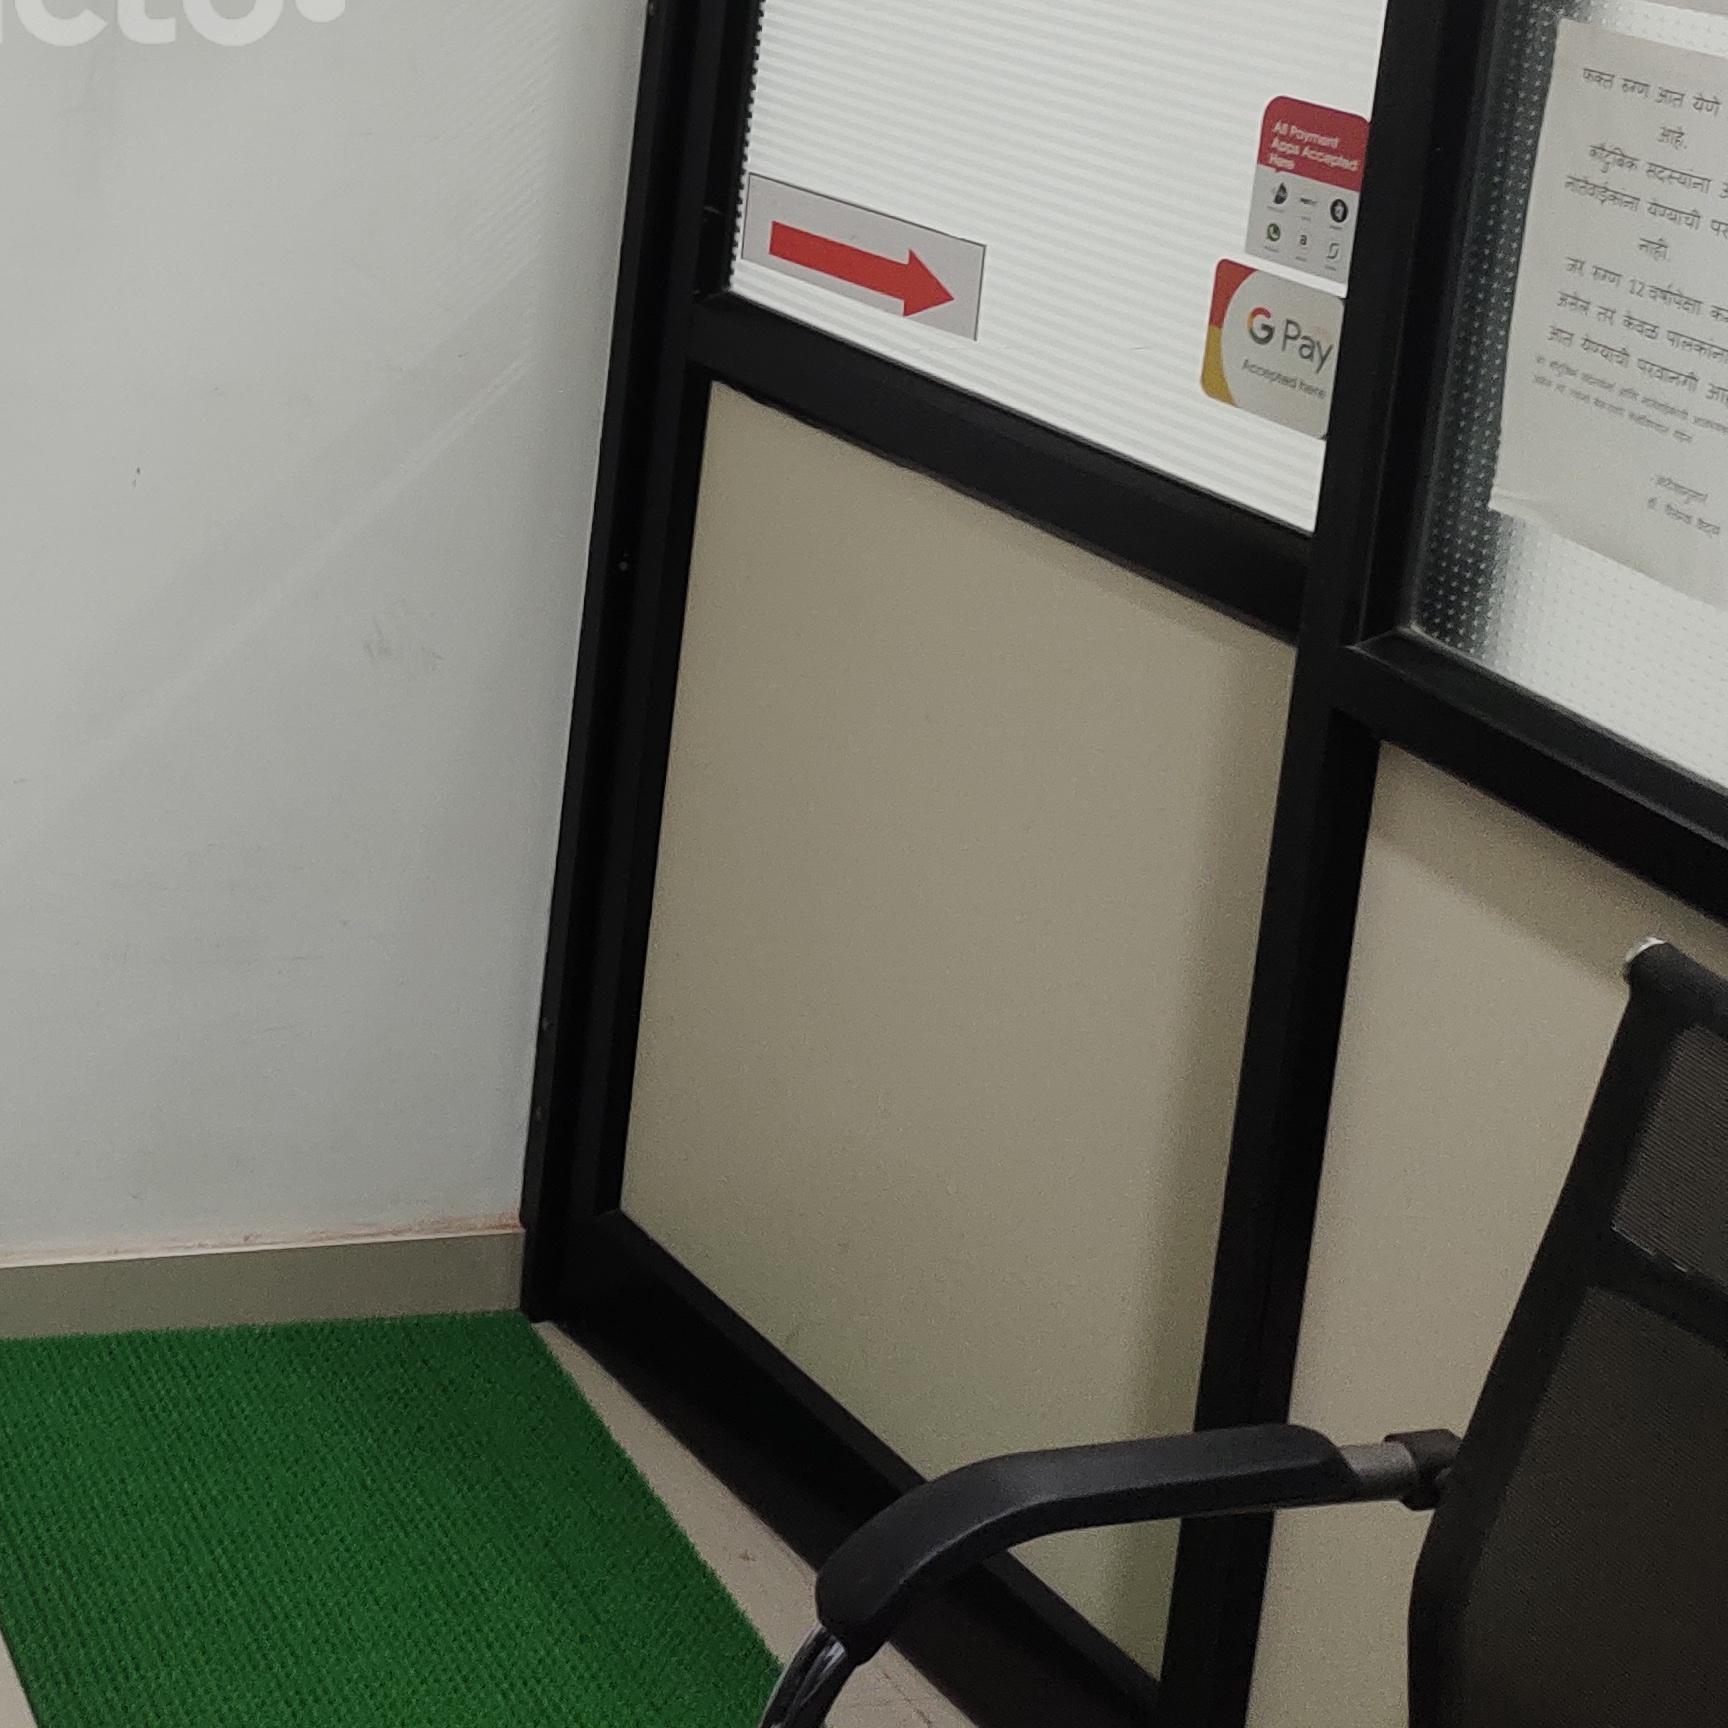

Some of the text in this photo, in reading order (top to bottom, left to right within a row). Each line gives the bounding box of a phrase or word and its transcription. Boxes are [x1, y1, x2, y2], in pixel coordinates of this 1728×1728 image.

[1272, 120, 1341, 149] All Payment
[1268, 152, 1296, 170] Here
[1271, 137, 1359, 172] Apps Accepted
[1246, 306, 1334, 373] G Pay
[1241, 358, 1298, 391] Accepted
